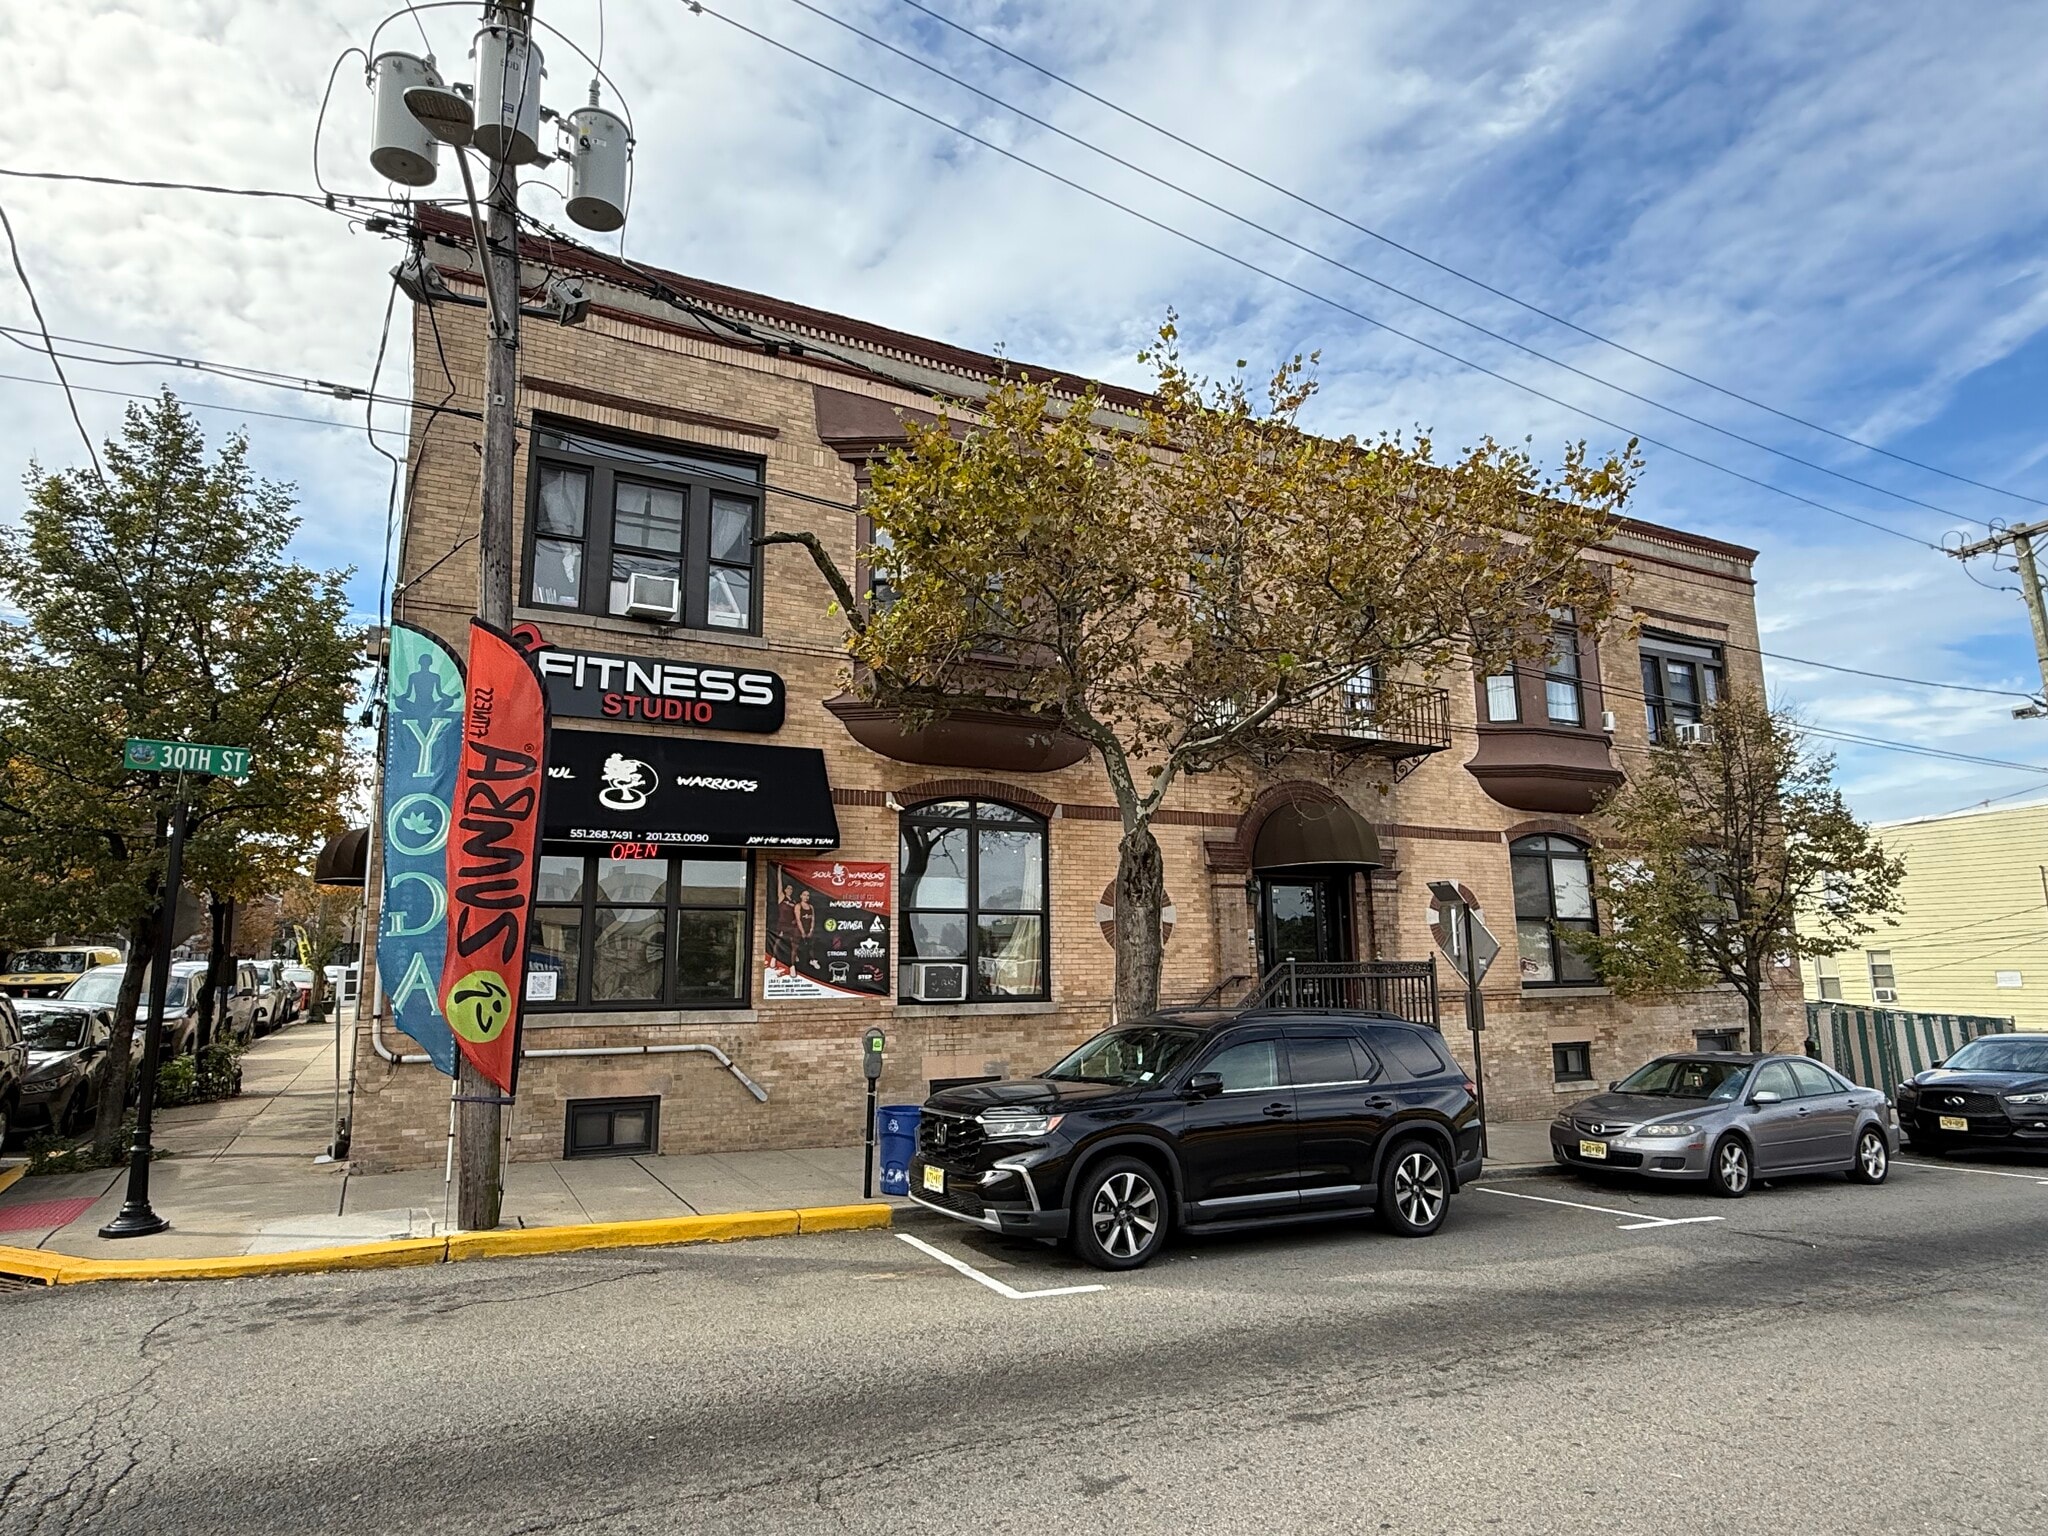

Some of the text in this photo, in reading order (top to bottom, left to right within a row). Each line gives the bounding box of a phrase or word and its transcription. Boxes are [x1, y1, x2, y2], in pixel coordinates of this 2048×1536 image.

[539, 651, 773, 705] FITNESS
[603, 693, 713, 723] STUDIO
[160, 745, 245, 773] 30TH ST
[676, 775, 758, 793] WARRIORS
[569, 828, 709, 844] 551.268.7491 201.233.0090
[611, 842, 658, 861] OPEN
[811, 870, 833, 879] SOUL
[864, 900, 884, 908] TEAM
